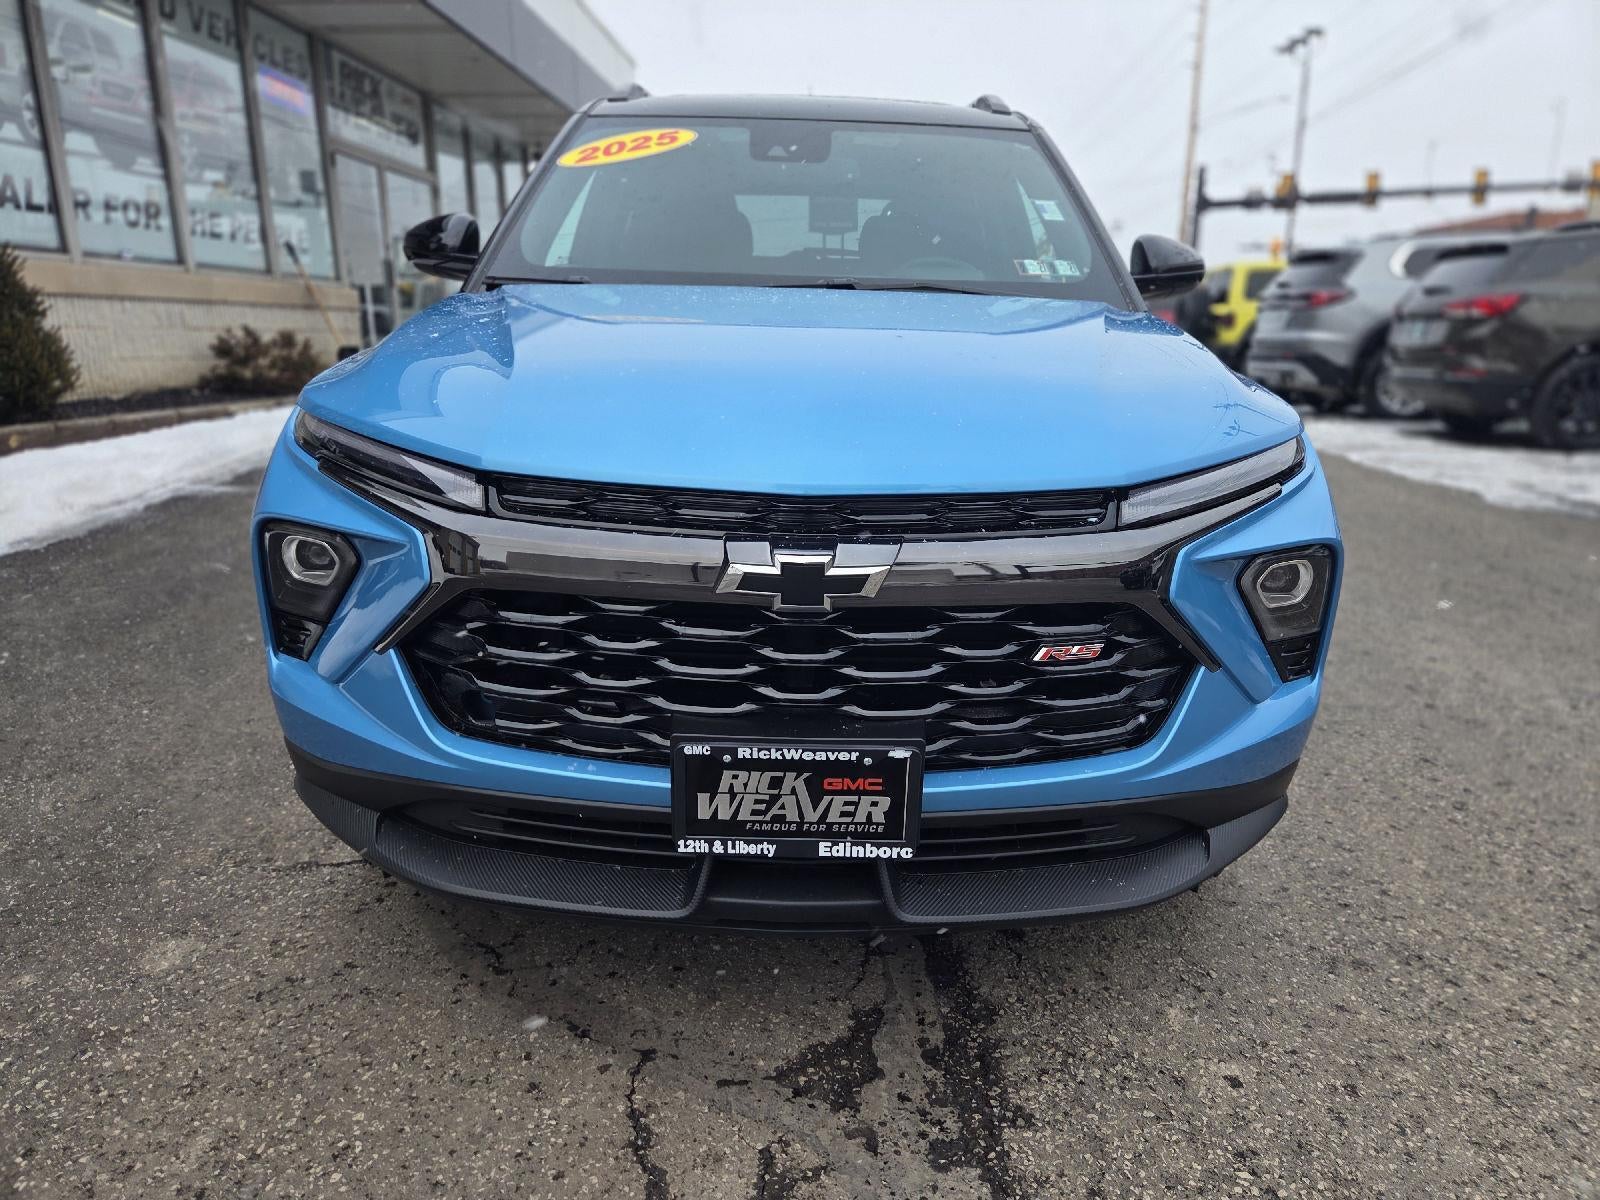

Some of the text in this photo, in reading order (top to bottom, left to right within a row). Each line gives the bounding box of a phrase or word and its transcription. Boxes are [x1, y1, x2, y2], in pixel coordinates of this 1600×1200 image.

[186, 0, 309, 79] VEHCLES
[575, 131, 679, 164] 2025
[104, 193, 162, 231] FOR
[1032, 643, 1105, 661] RS
[684, 745, 711, 755] GMC
[718, 770, 883, 795] RICK GMC
[697, 792, 891, 823] WEAVER
[746, 822, 884, 833] FAMOUS FOR SERVICE
[677, 840, 777, 857] 12th & Liberty
